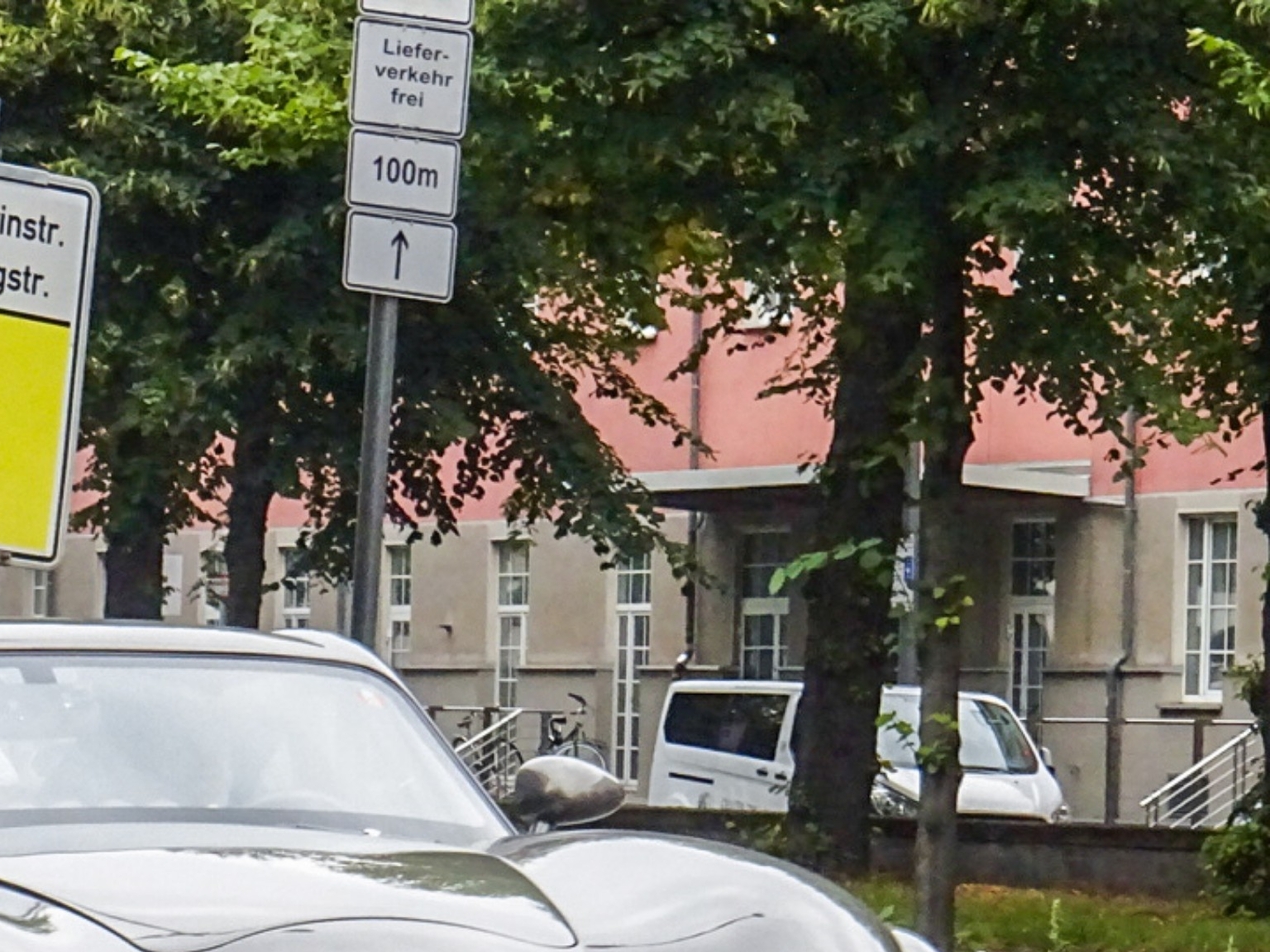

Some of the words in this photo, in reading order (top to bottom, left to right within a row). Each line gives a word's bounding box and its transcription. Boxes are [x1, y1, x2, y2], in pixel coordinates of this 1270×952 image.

[383, 38, 450, 61] Liefer-
[375, 64, 454, 87] verkehr
[390, 87, 425, 108] frei
[373, 156, 439, 189] 100m
